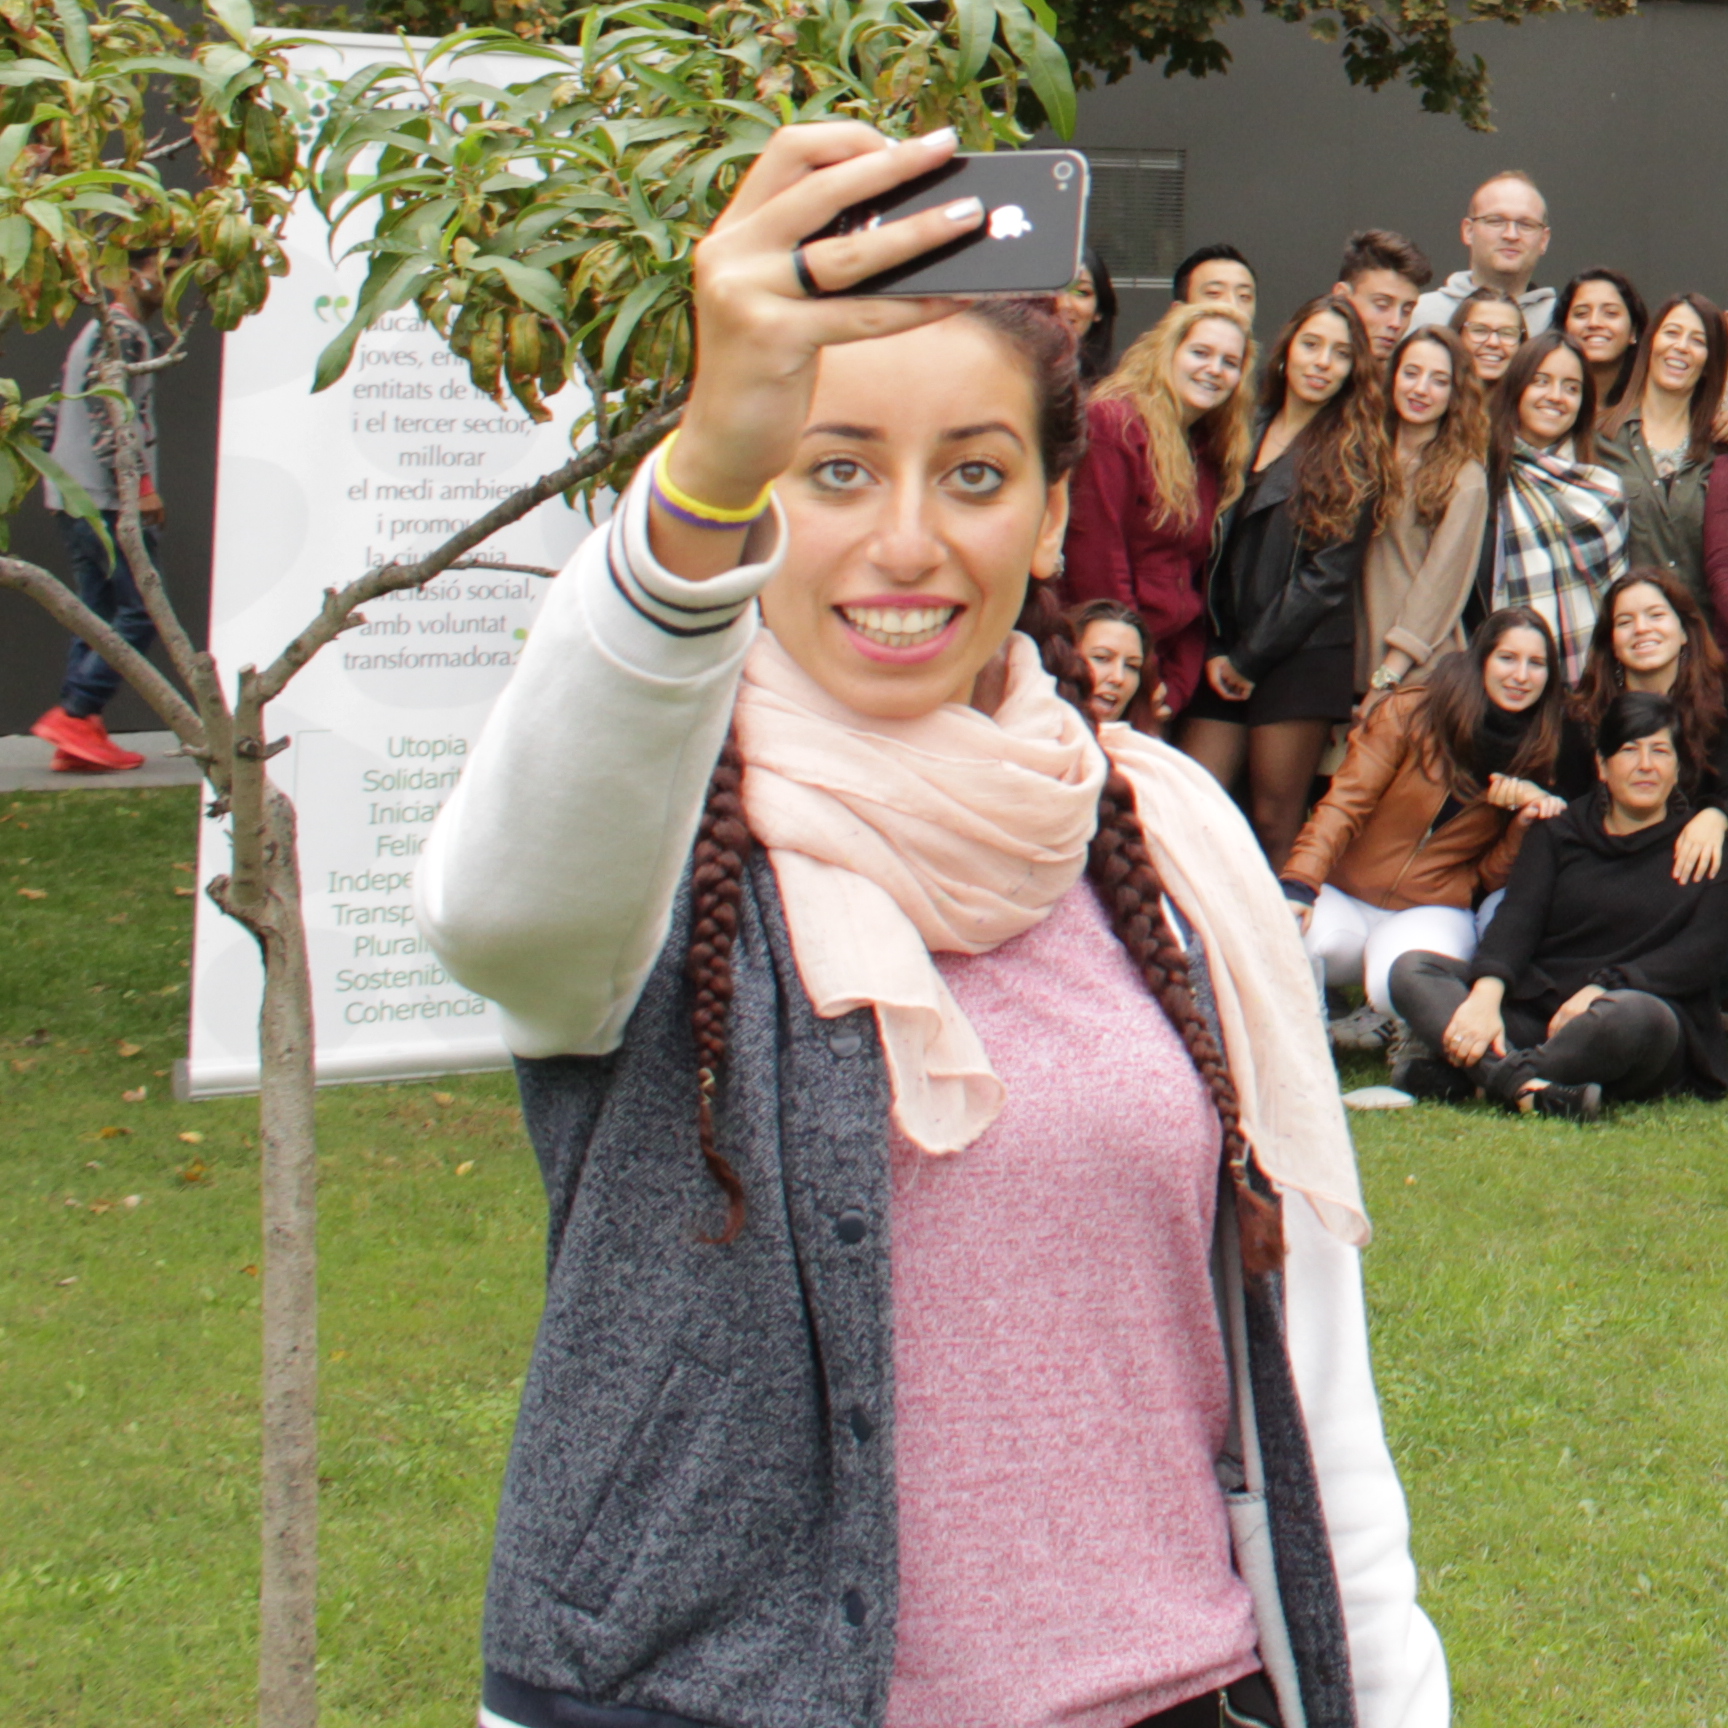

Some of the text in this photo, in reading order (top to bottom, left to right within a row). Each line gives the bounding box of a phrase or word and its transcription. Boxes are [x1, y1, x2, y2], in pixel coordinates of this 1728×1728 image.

[358, 343, 424, 371] joves,
[353, 377, 433, 400] entitats
[439, 377, 468, 400] de
[352, 411, 532, 438] i el tercer sector,
[398, 444, 486, 467] millorar
[347, 478, 368, 501] el
[375, 477, 433, 500] medi
[376, 514, 383, 535] i
[365, 546, 385, 568] la
[466, 577, 537, 603] social,
[359, 611, 507, 636] amb voluntat
[387, 734, 468, 761] Utopia
[344, 995, 486, 1024] Coherència
